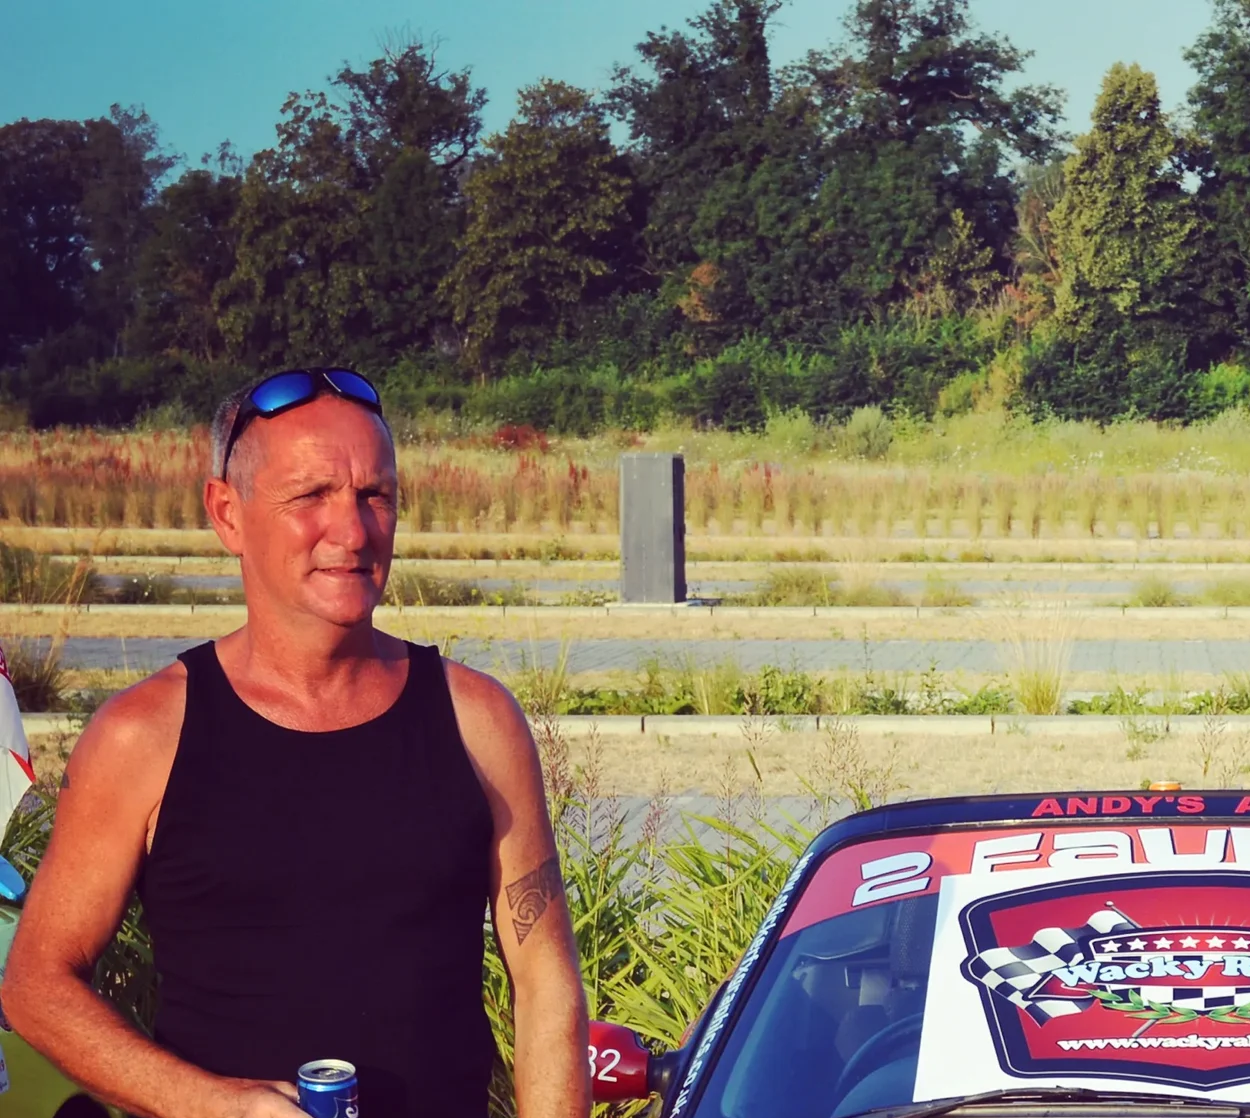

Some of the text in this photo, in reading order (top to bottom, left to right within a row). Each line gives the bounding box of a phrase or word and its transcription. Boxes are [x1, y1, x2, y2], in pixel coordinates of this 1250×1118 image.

[1031, 795, 1206, 817] ANDY'S
[850, 850, 937, 908] 2
[1051, 954, 1214, 988] Wacky
